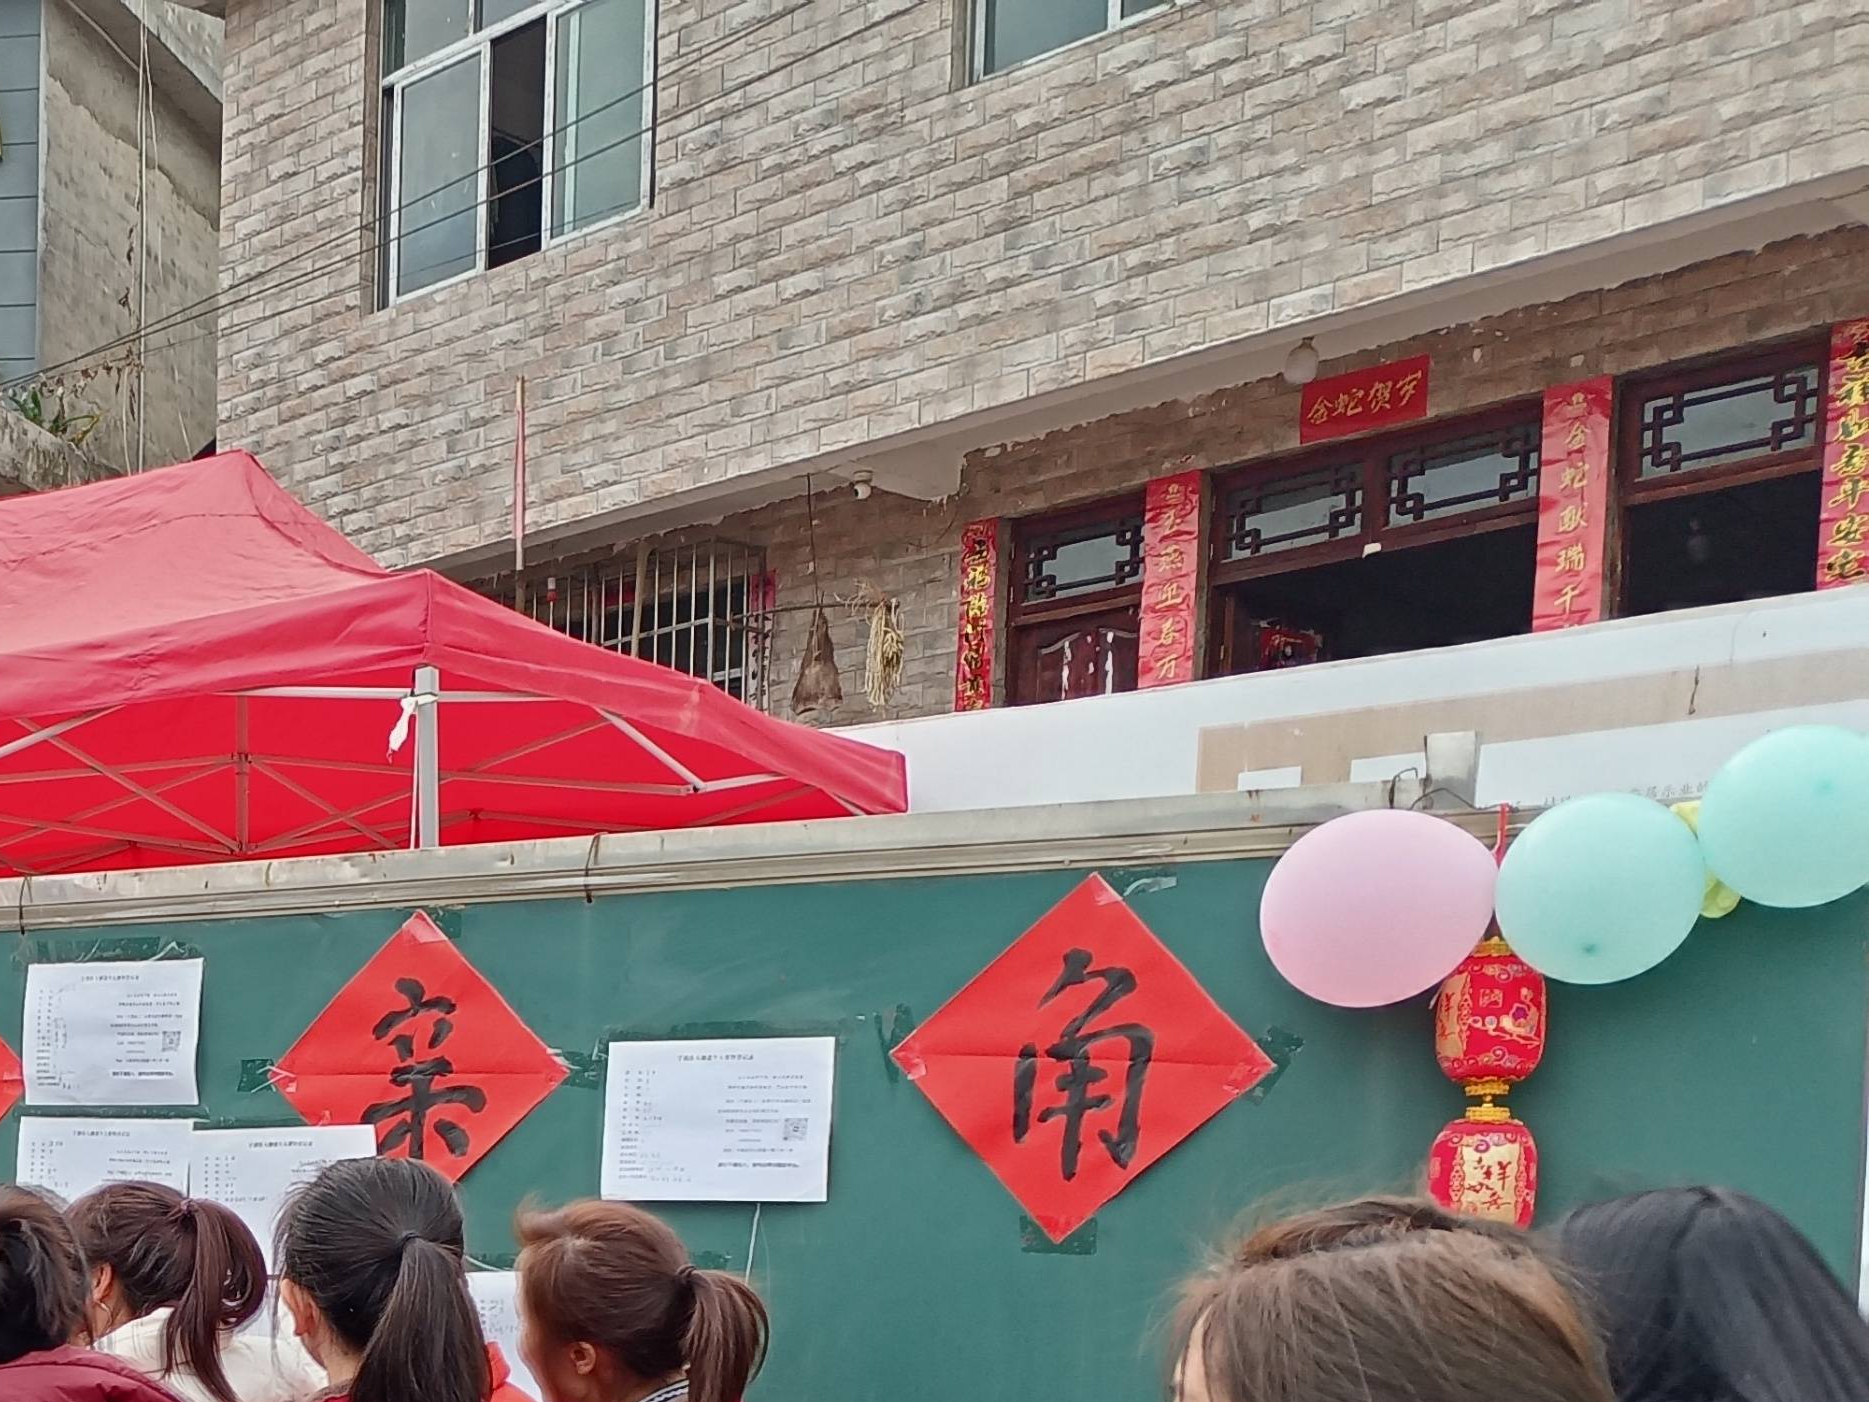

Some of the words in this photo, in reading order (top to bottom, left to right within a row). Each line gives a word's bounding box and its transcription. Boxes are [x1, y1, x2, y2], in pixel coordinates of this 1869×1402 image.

[1553, 421, 1591, 630] 金蛇献瑞千
[359, 977, 486, 1160] 亲
[1012, 949, 1154, 1183] 角
